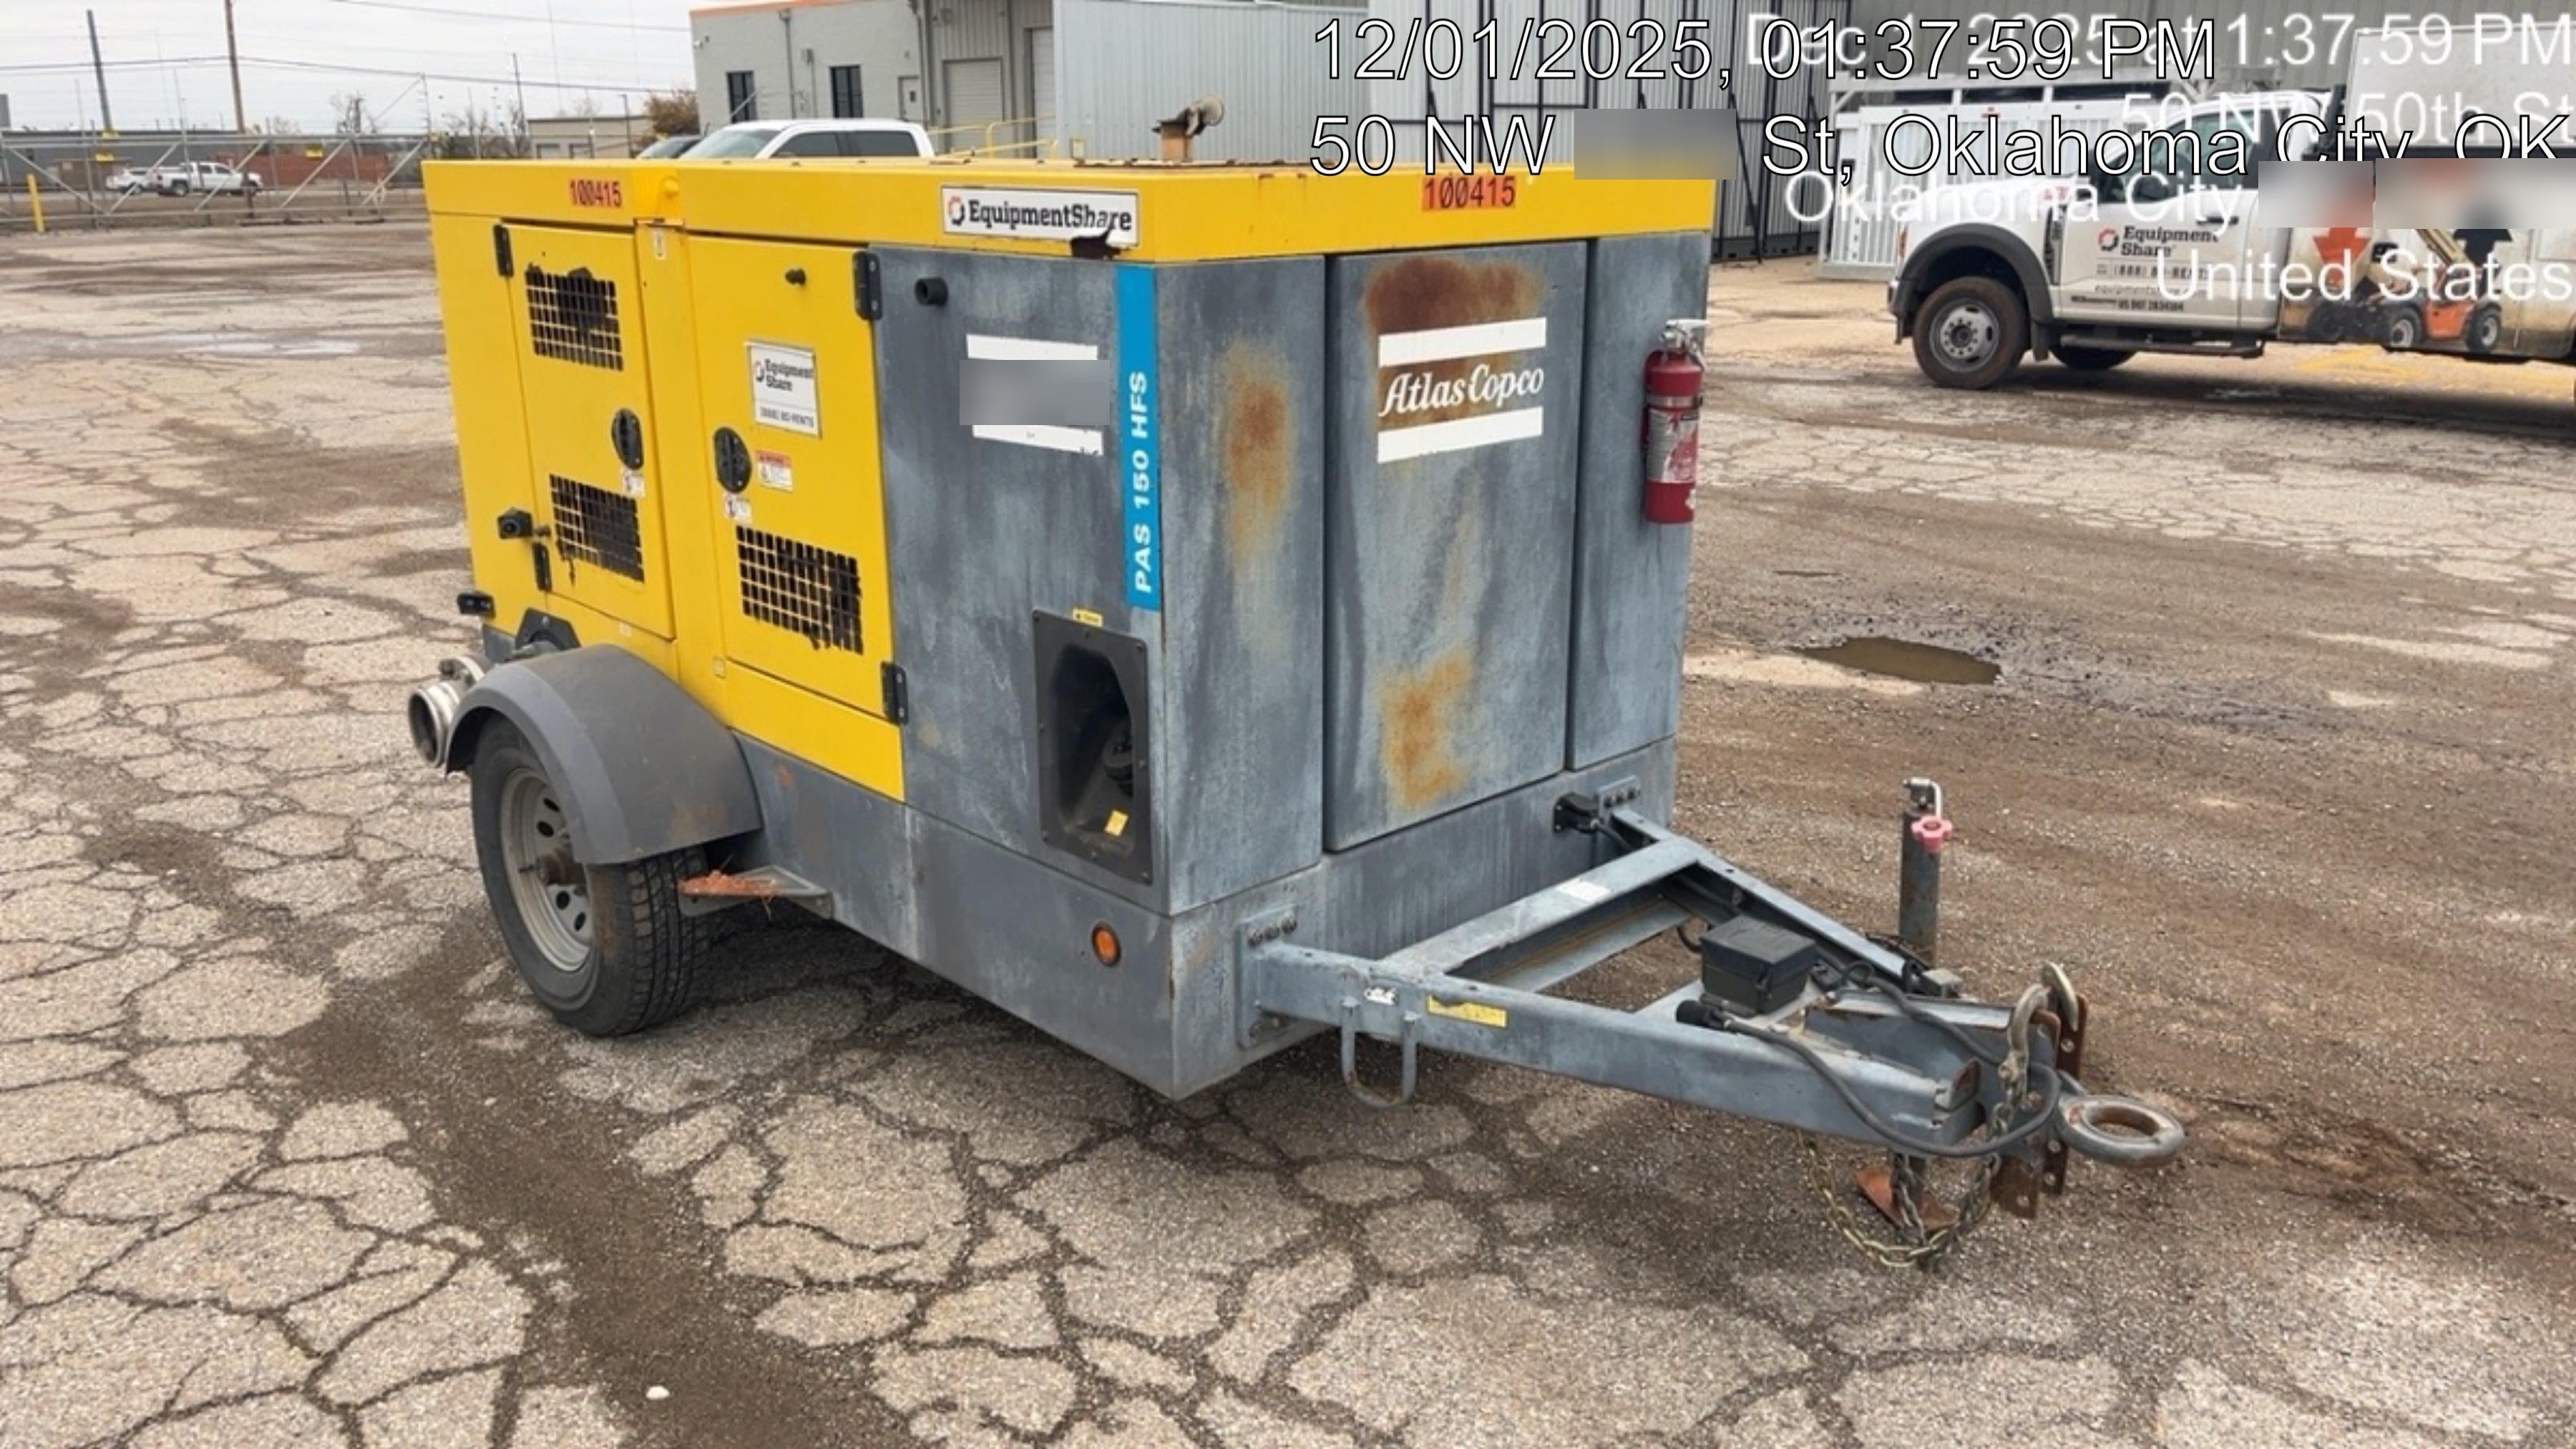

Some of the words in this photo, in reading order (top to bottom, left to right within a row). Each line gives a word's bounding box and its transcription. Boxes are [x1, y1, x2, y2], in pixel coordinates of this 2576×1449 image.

[570, 180, 623, 208] 100415
[1425, 176, 1514, 208] 100415
[968, 200, 1132, 230] EquipmentShare
[764, 358, 814, 379] Equipment
[766, 374, 793, 391] Share
[1128, 371, 1148, 439] HFS
[1132, 449, 1151, 510] 150
[1133, 523, 1153, 594] PAS
